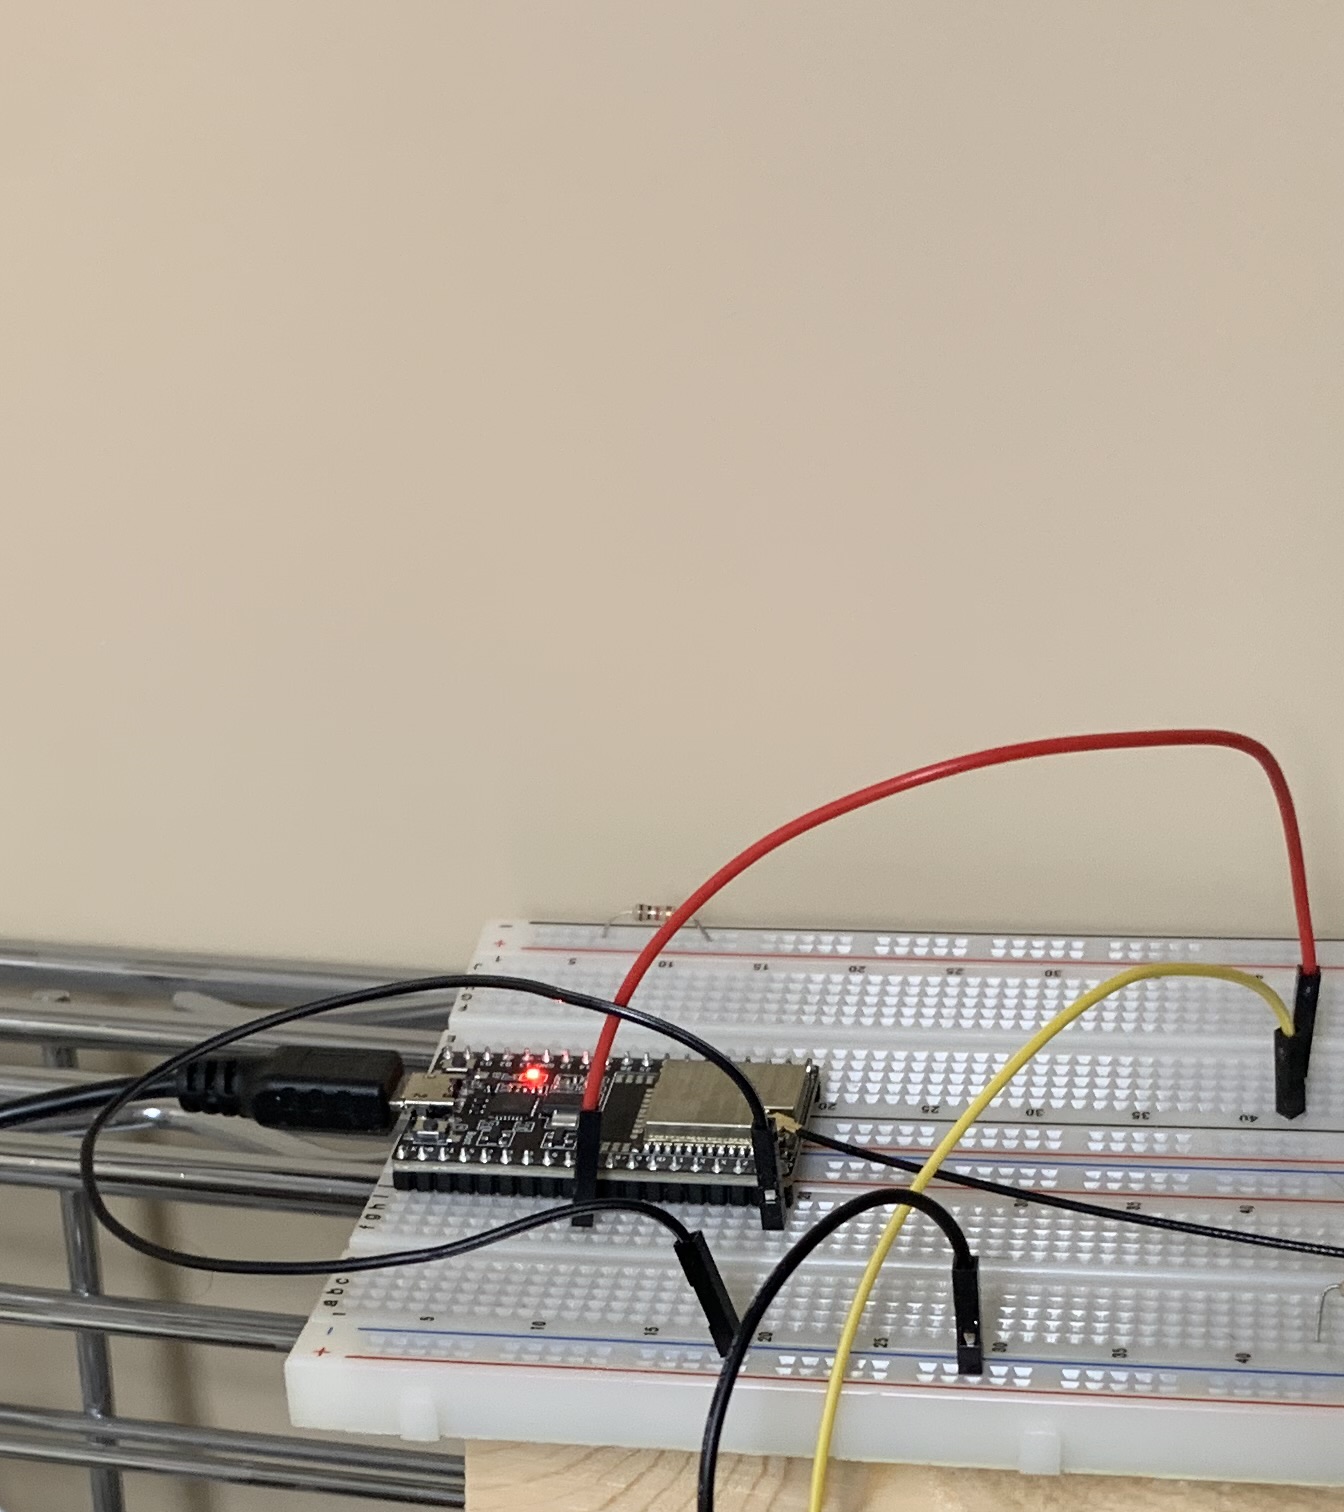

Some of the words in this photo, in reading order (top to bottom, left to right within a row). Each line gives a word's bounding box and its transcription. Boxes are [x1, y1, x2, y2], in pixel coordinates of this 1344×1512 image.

[494, 955, 501, 963] 1
[568, 957, 577, 966] 5
[753, 962, 770, 972] 15
[848, 965, 867, 974] 20
[945, 967, 965, 976] 25
[1044, 969, 1062, 978] 30
[819, 1103, 836, 1111] 20
[921, 1105, 941, 1114] 25
[1025, 1108, 1044, 1117] 30
[1131, 1110, 1151, 1121] 35
[1237, 1114, 1259, 1122] 40
[529, 1320, 547, 1330] 10
[643, 1326, 660, 1336] 15
[758, 1331, 773, 1343] 20
[872, 1337, 889, 1349] 25
[992, 1342, 1008, 1353] 30
[1111, 1347, 1128, 1359] 35
[1234, 1352, 1252, 1364] 40
